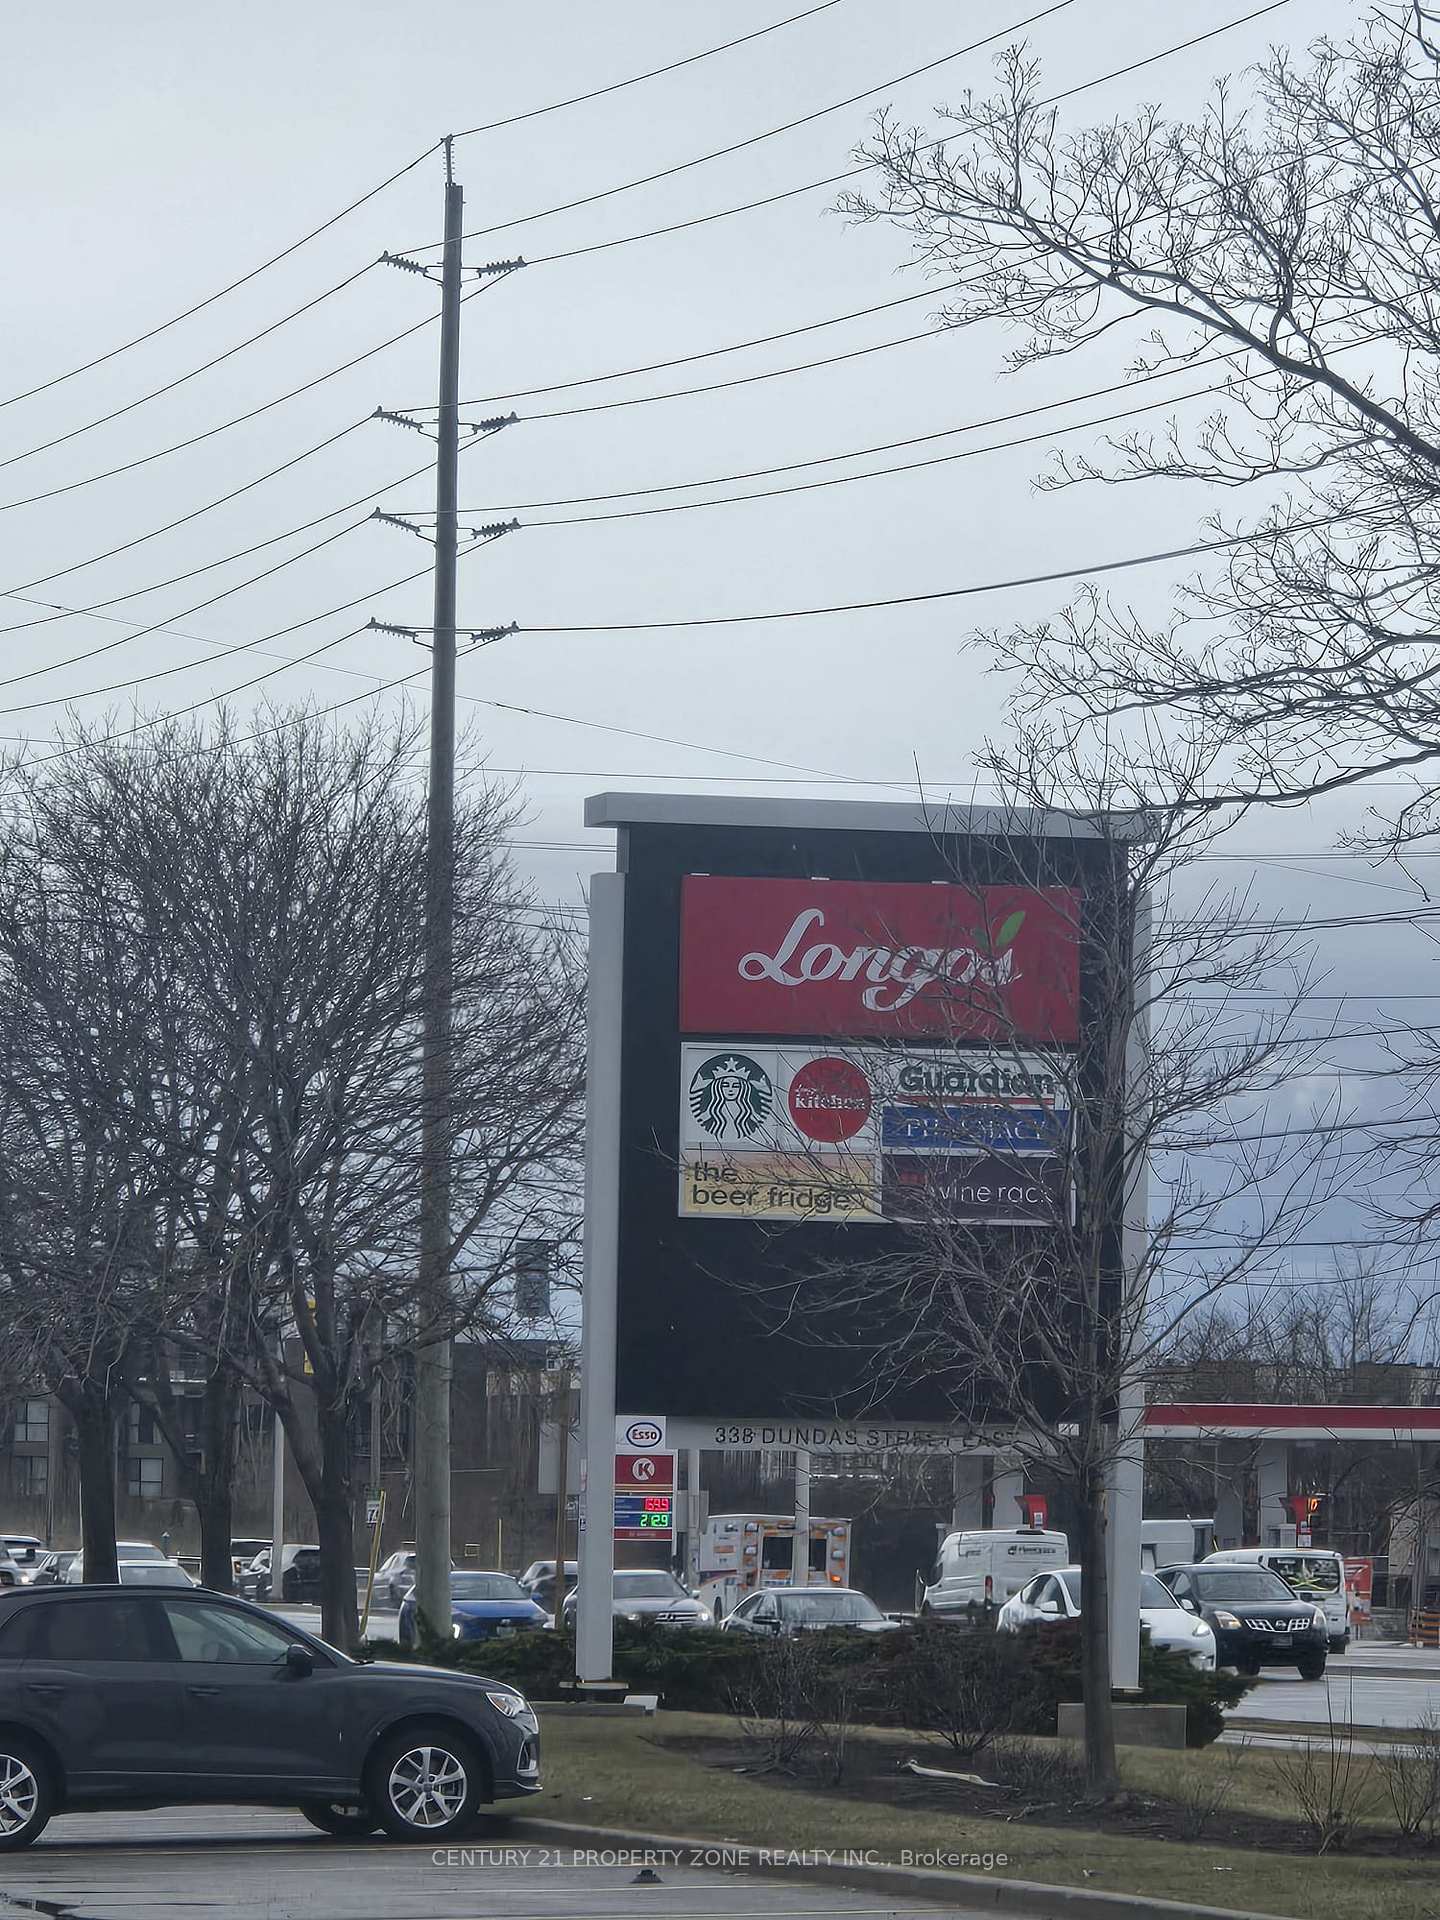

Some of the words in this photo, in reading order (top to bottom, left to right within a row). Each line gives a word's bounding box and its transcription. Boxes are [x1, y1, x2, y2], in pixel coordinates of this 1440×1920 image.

[901, 1065, 1055, 1097] Guardian
[694, 1161, 737, 1183] the
[692, 1184, 758, 1206] beer
[768, 1186, 849, 1214] fridge
[715, 1426, 754, 1444] 338
[762, 1427, 857, 1445] DUNDAS
